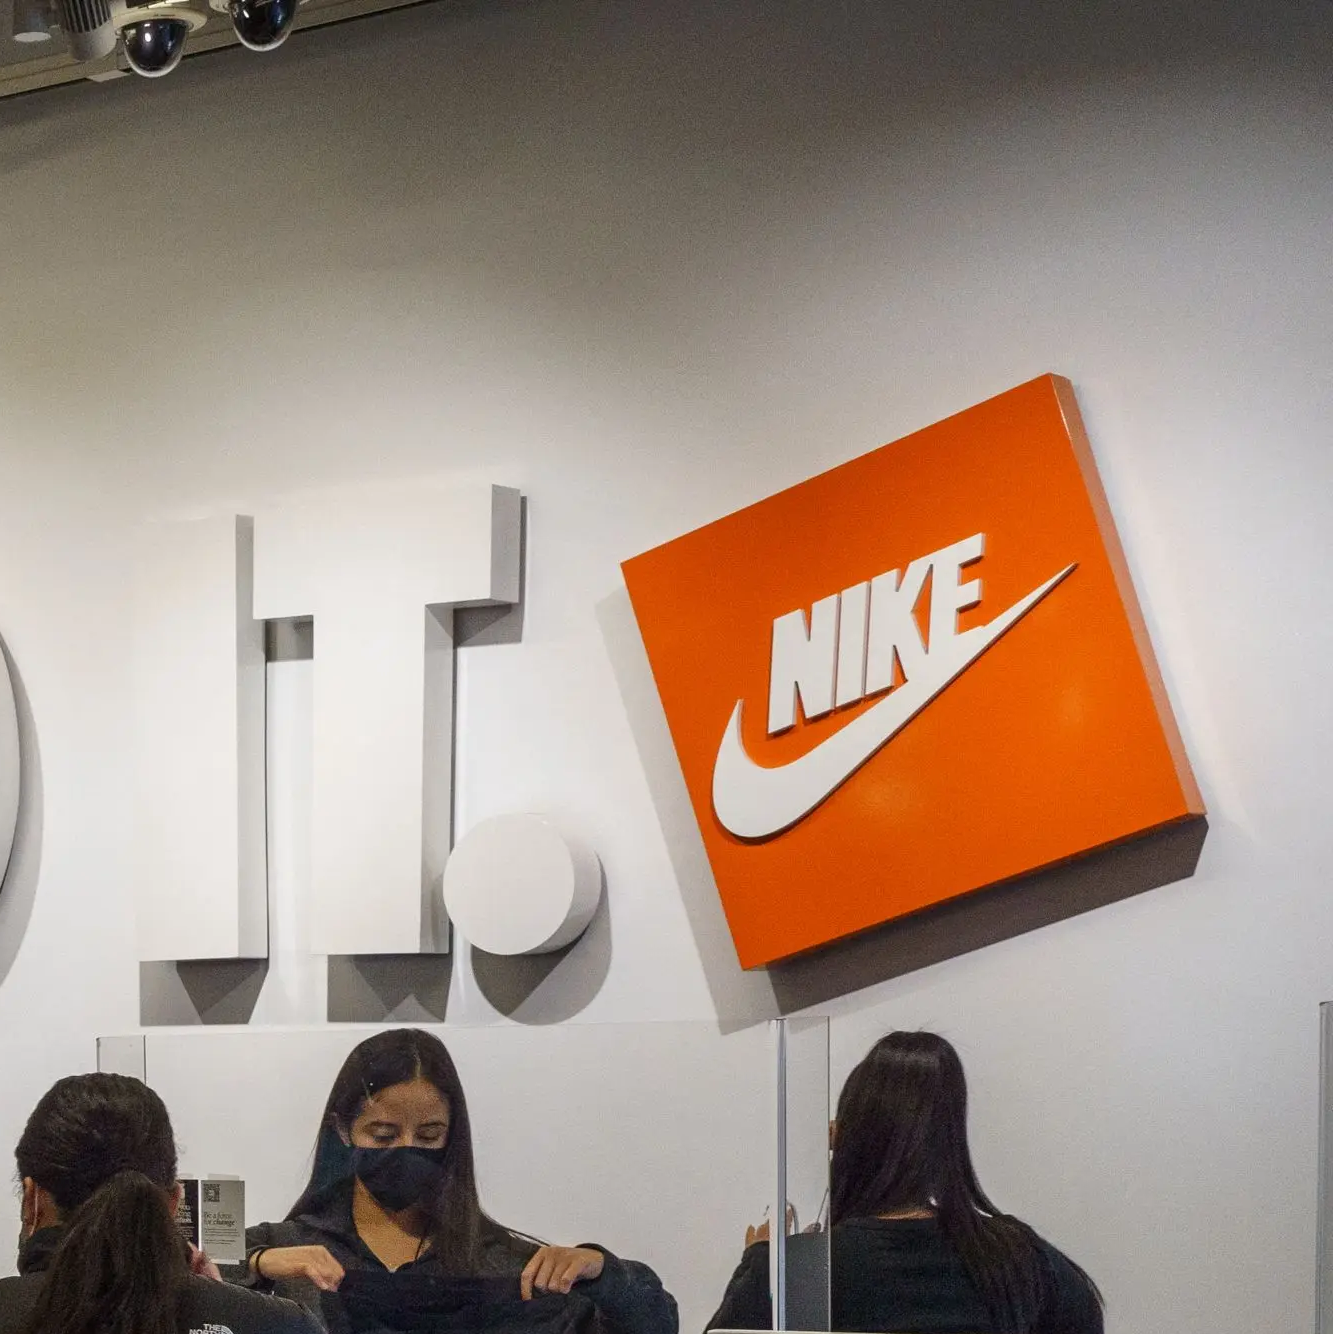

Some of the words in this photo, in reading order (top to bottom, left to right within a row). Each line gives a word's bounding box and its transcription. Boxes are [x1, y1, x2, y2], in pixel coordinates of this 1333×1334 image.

[138, 485, 601, 960] IT.
[767, 533, 986, 737] NIKE
[203, 1323, 222, 1331] THE
